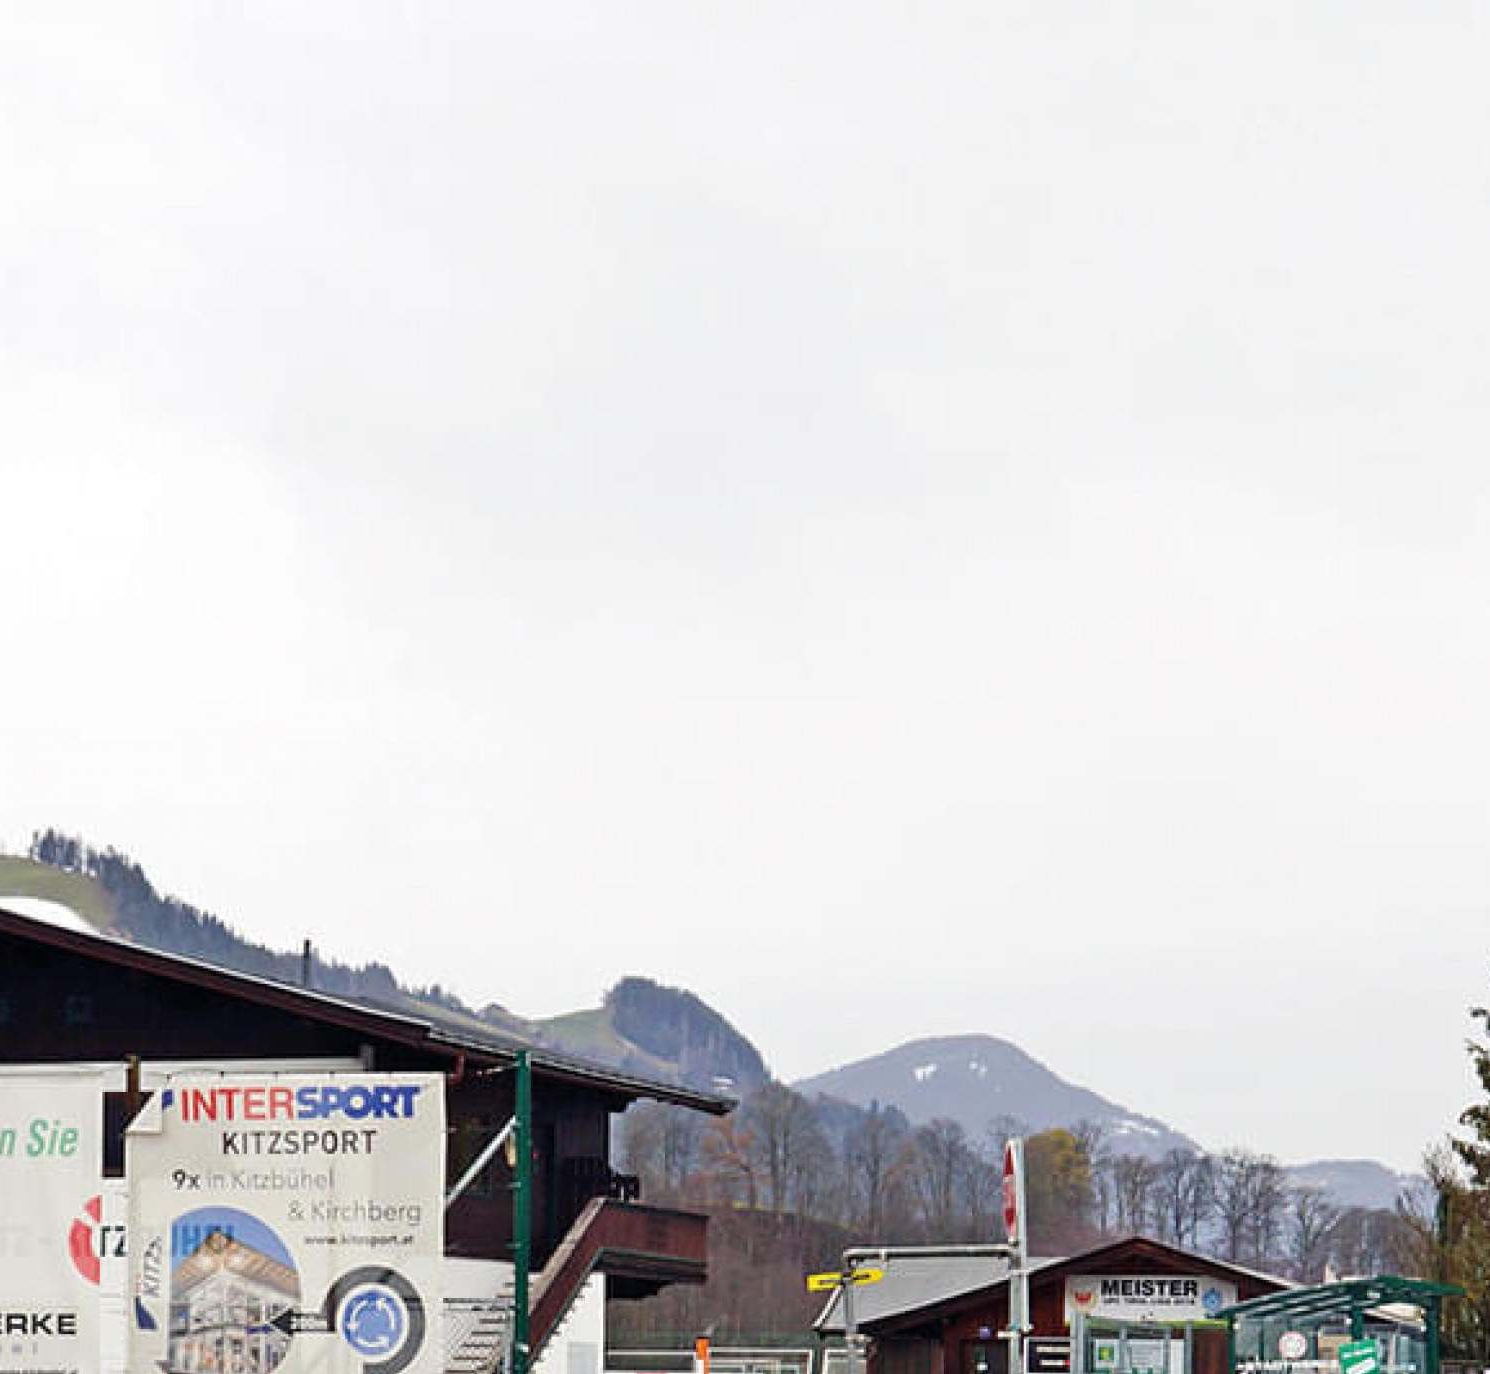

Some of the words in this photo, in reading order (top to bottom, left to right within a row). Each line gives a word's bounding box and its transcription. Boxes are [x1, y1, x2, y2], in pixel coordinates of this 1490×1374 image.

[181, 1086, 423, 1121] INTERSPORT
[26, 1119, 80, 1157] Sie
[223, 1130, 378, 1155] KITZSPORT
[173, 1168, 201, 1190] 9x
[208, 1171, 226, 1189] in
[232, 1167, 335, 1190] Kitzbühel
[288, 1200, 304, 1221] &
[311, 1200, 422, 1226] Kirchberg
[1100, 1278, 1198, 1297] MEISTER
